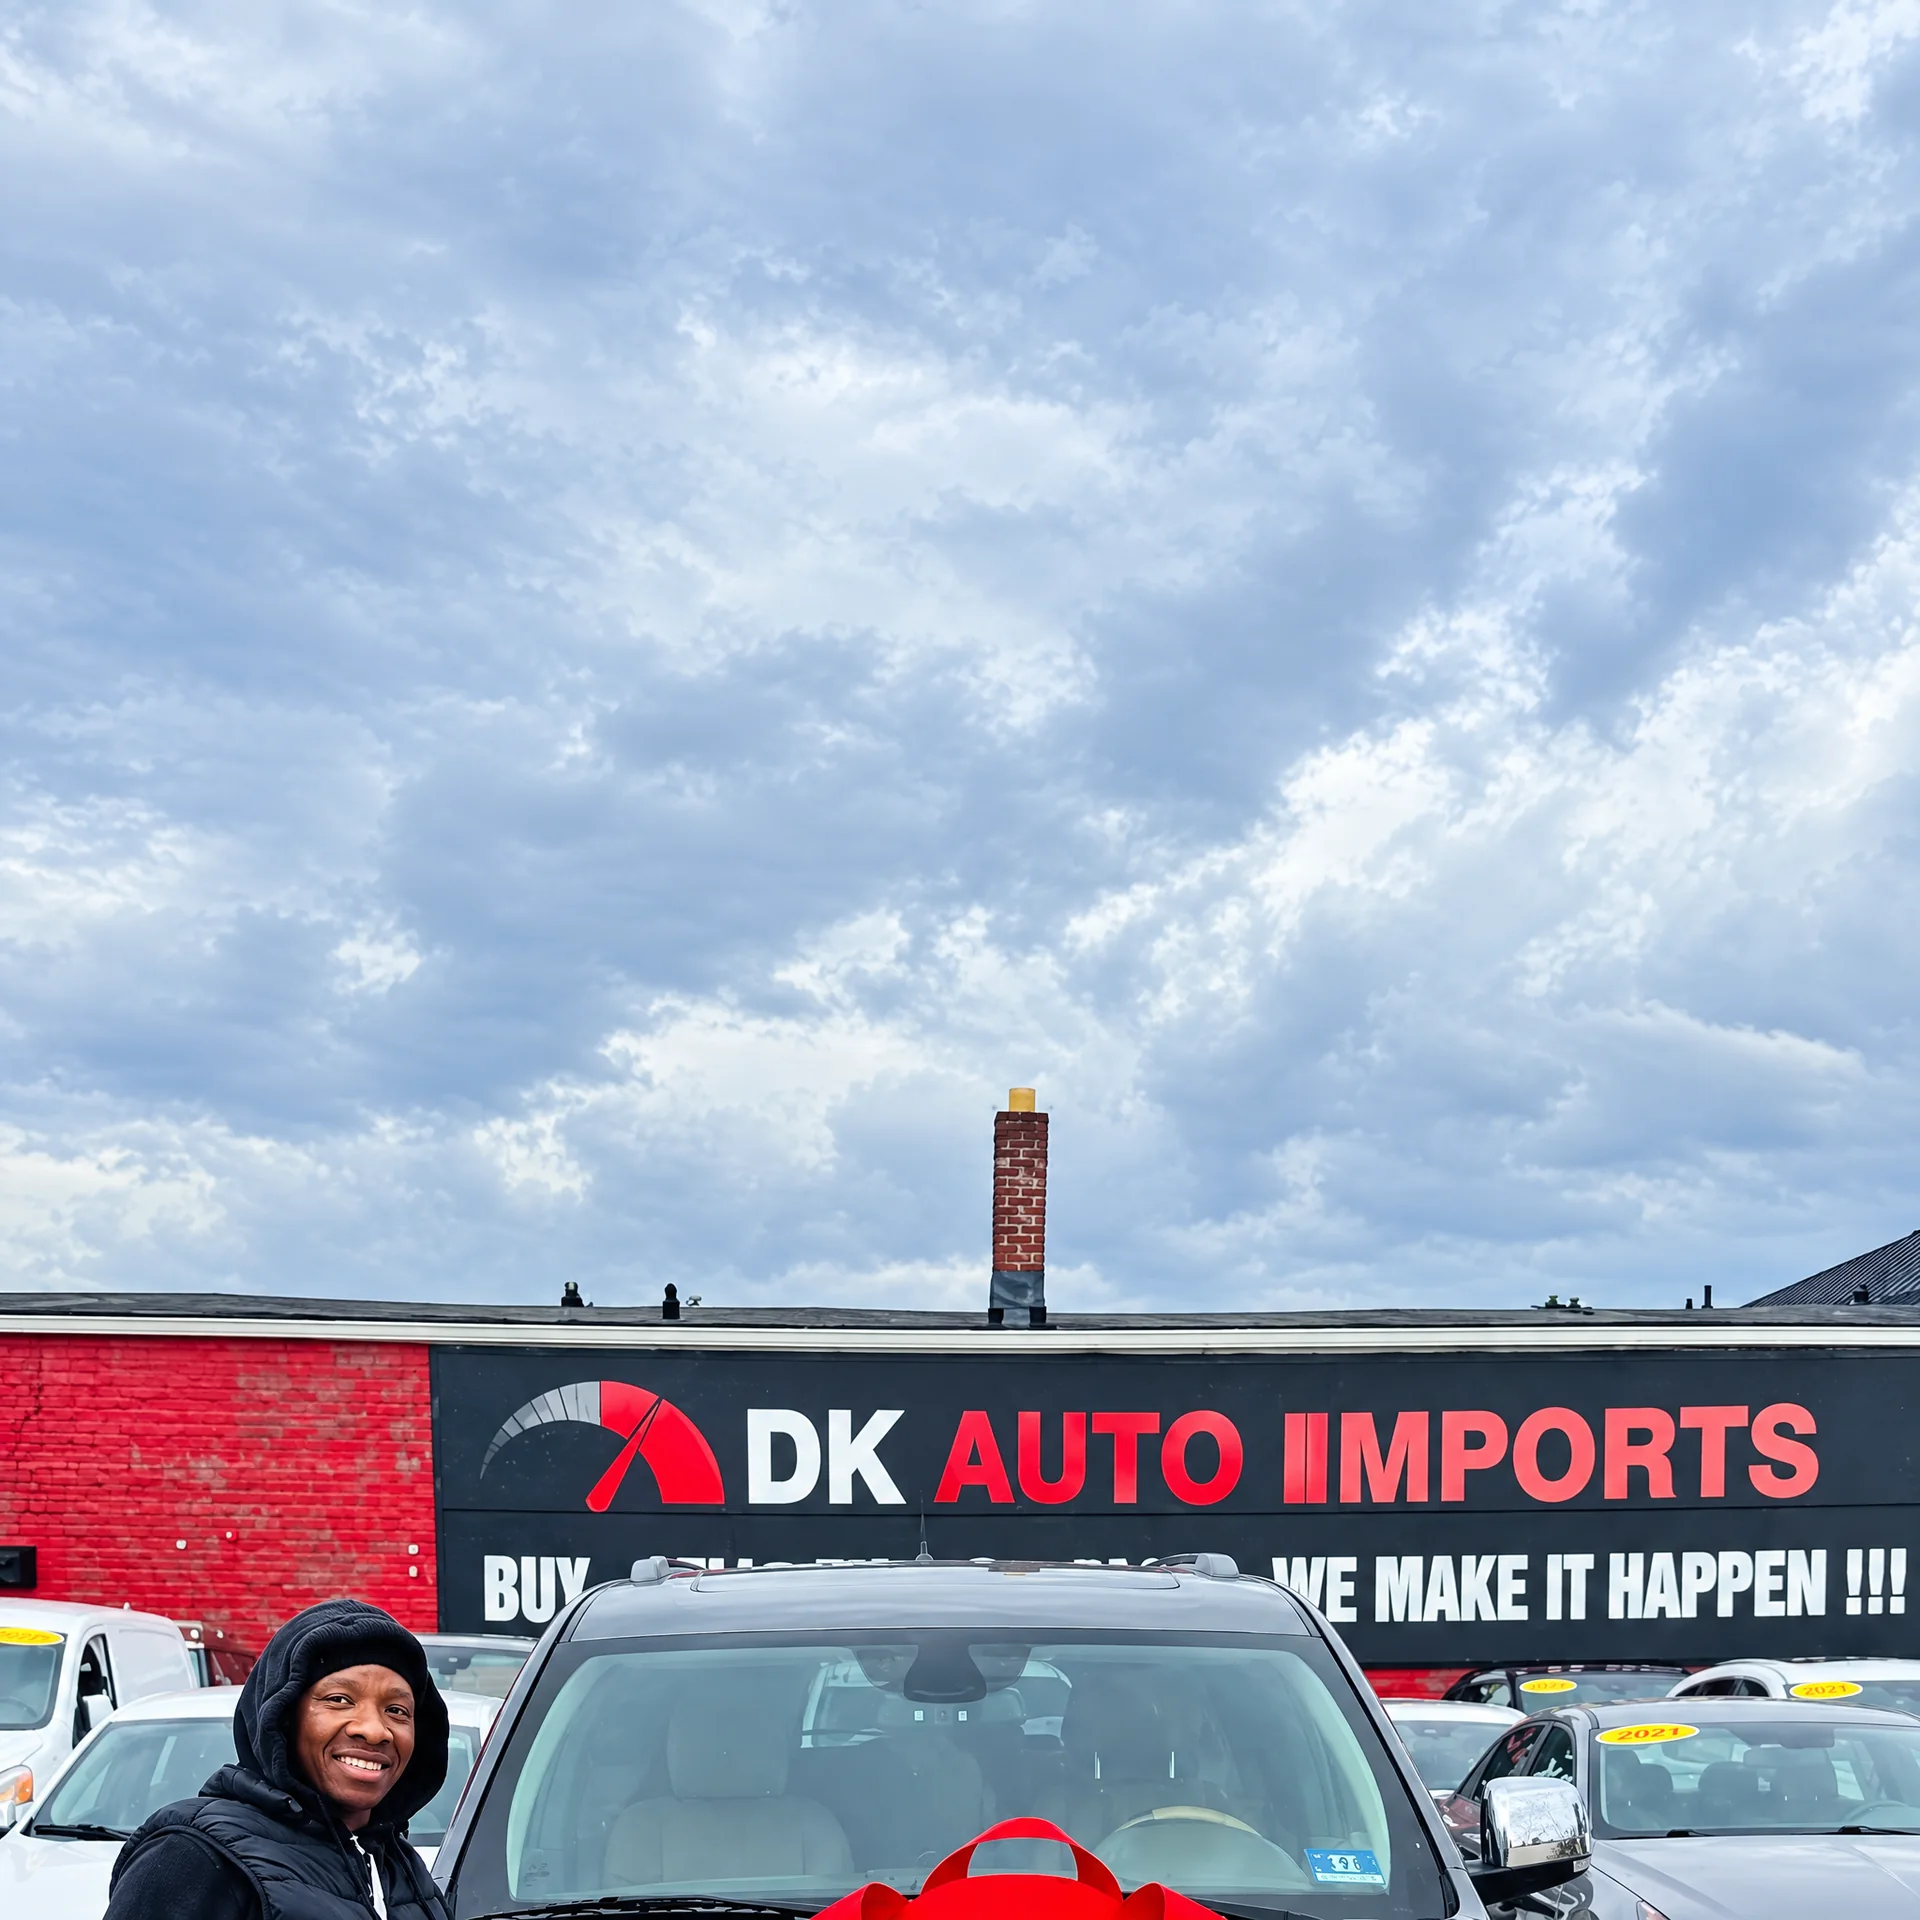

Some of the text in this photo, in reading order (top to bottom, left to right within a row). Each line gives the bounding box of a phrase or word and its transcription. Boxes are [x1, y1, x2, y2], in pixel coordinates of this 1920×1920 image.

[747, 1408, 907, 1505] DK
[933, 1409, 1245, 1506] AUTO
[483, 1554, 592, 1623] BUY
[1374, 1553, 1529, 1623] MAKE
[1546, 1553, 1595, 1621] IT
[1608, 1549, 1827, 1620] HAPPEN
[1845, 1547, 1907, 1615] !!!
[1803, 1684, 1848, 1696] 2021
[1617, 1727, 1681, 1741] 2021
